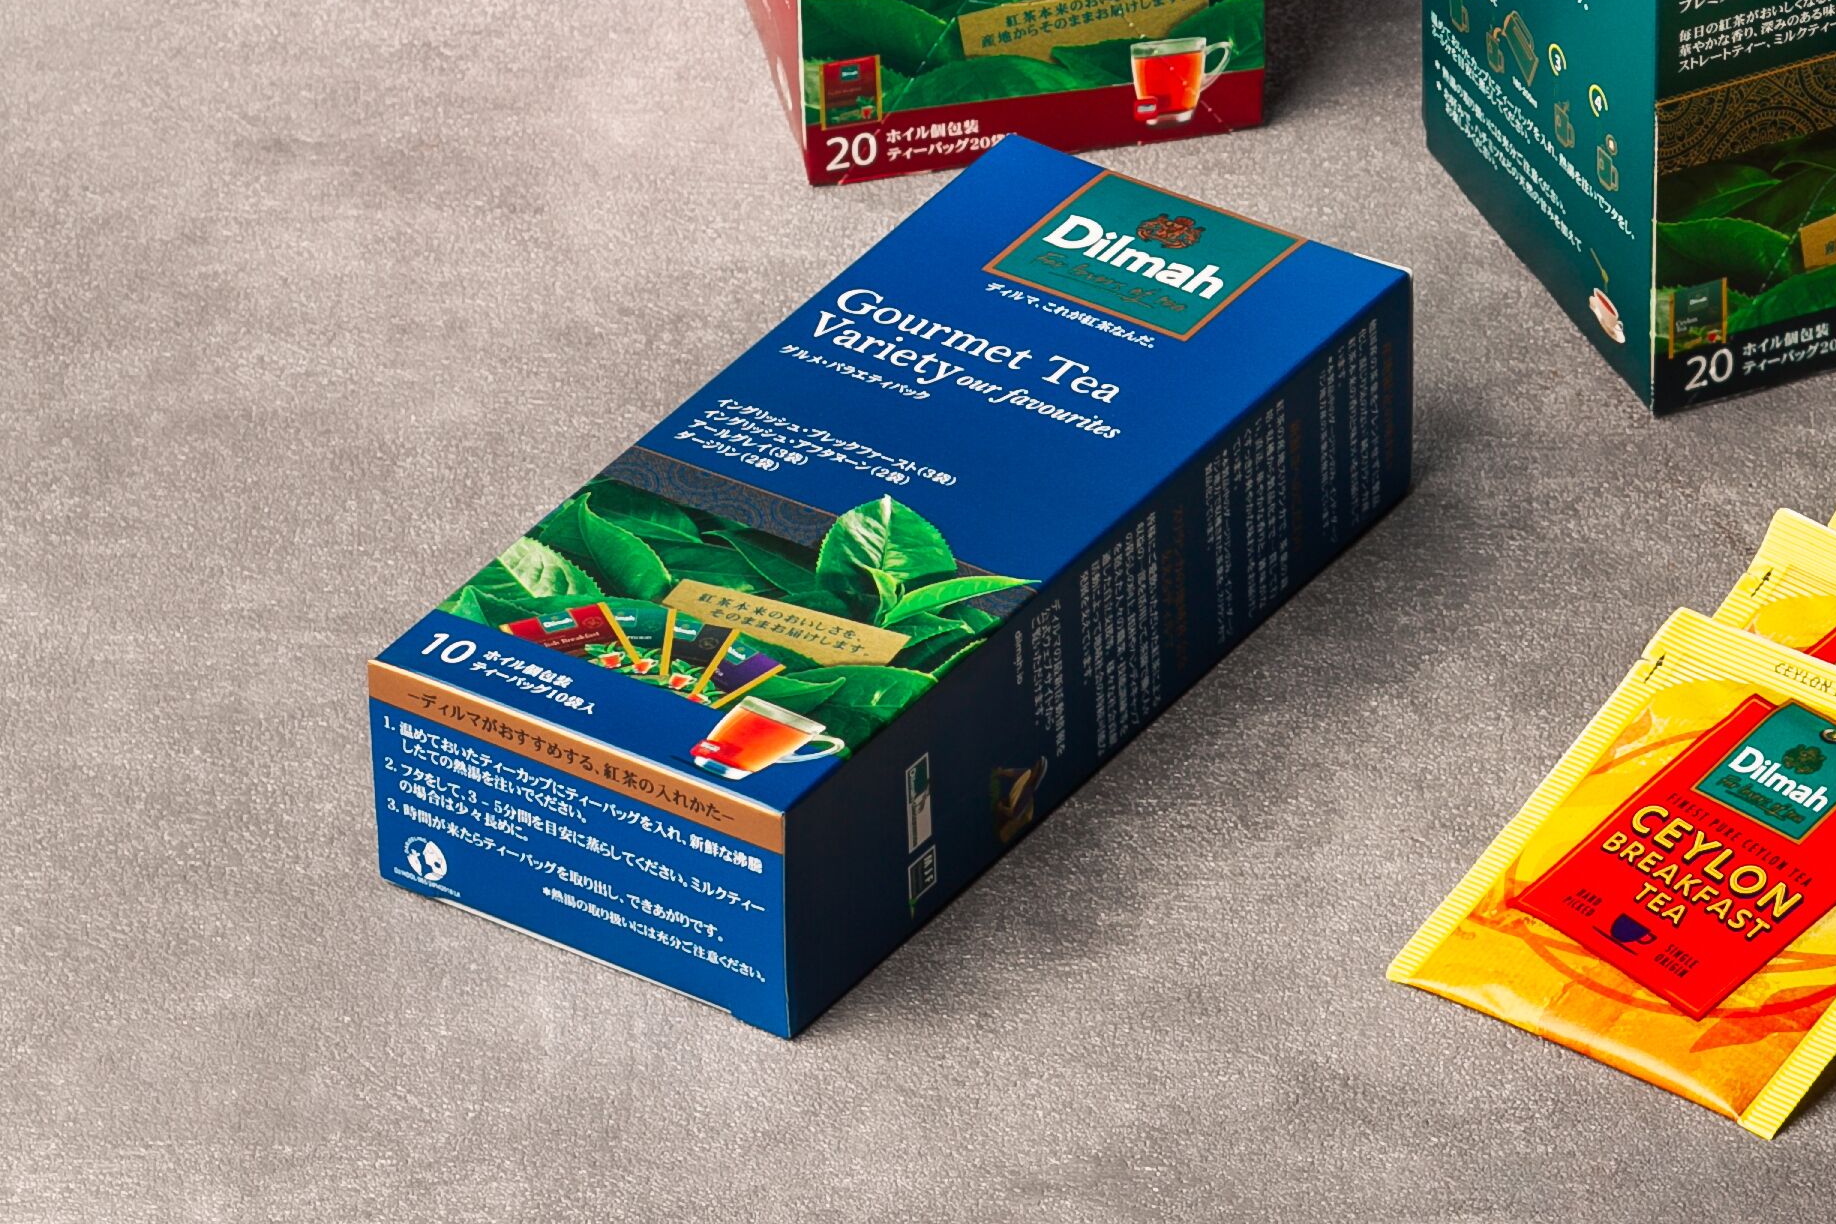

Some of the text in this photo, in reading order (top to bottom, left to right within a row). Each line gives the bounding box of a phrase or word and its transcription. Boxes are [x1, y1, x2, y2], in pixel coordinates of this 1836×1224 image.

[825, 131, 878, 172] 20
[1042, 214, 1225, 302] Dilmah
[985, 282, 1155, 349] ディルマ、これが紅茶なんだ。
[836, 286, 1121, 404] Gourmet Tea
[1742, 322, 1831, 356] ホイル個包装
[779, 342, 931, 402] グルメ・バラエティパック
[811, 309, 1121, 440] Variety our favourites
[1685, 346, 1734, 392] 20
[418, 631, 475, 665] 10
[1774, 662, 1832, 693] CEYLON
[383, 716, 397, 731] 1.
[384, 758, 399, 774] 2.
[1727, 746, 1829, 814] Dilmah
[386, 798, 400, 814] 3.
[1665, 792, 1814, 888] FINEST PURE CEYLON TEA
[1631, 804, 1804, 922] CEYLON
[1562, 894, 1596, 919] PICKED
[1575, 888, 1603, 908] HAND
[1601, 831, 1773, 942] BREAKFAST
[1633, 881, 1689, 929] TEA
[1653, 952, 1690, 979] ORIGIN
[1664, 942, 1699, 971] SINGLE
